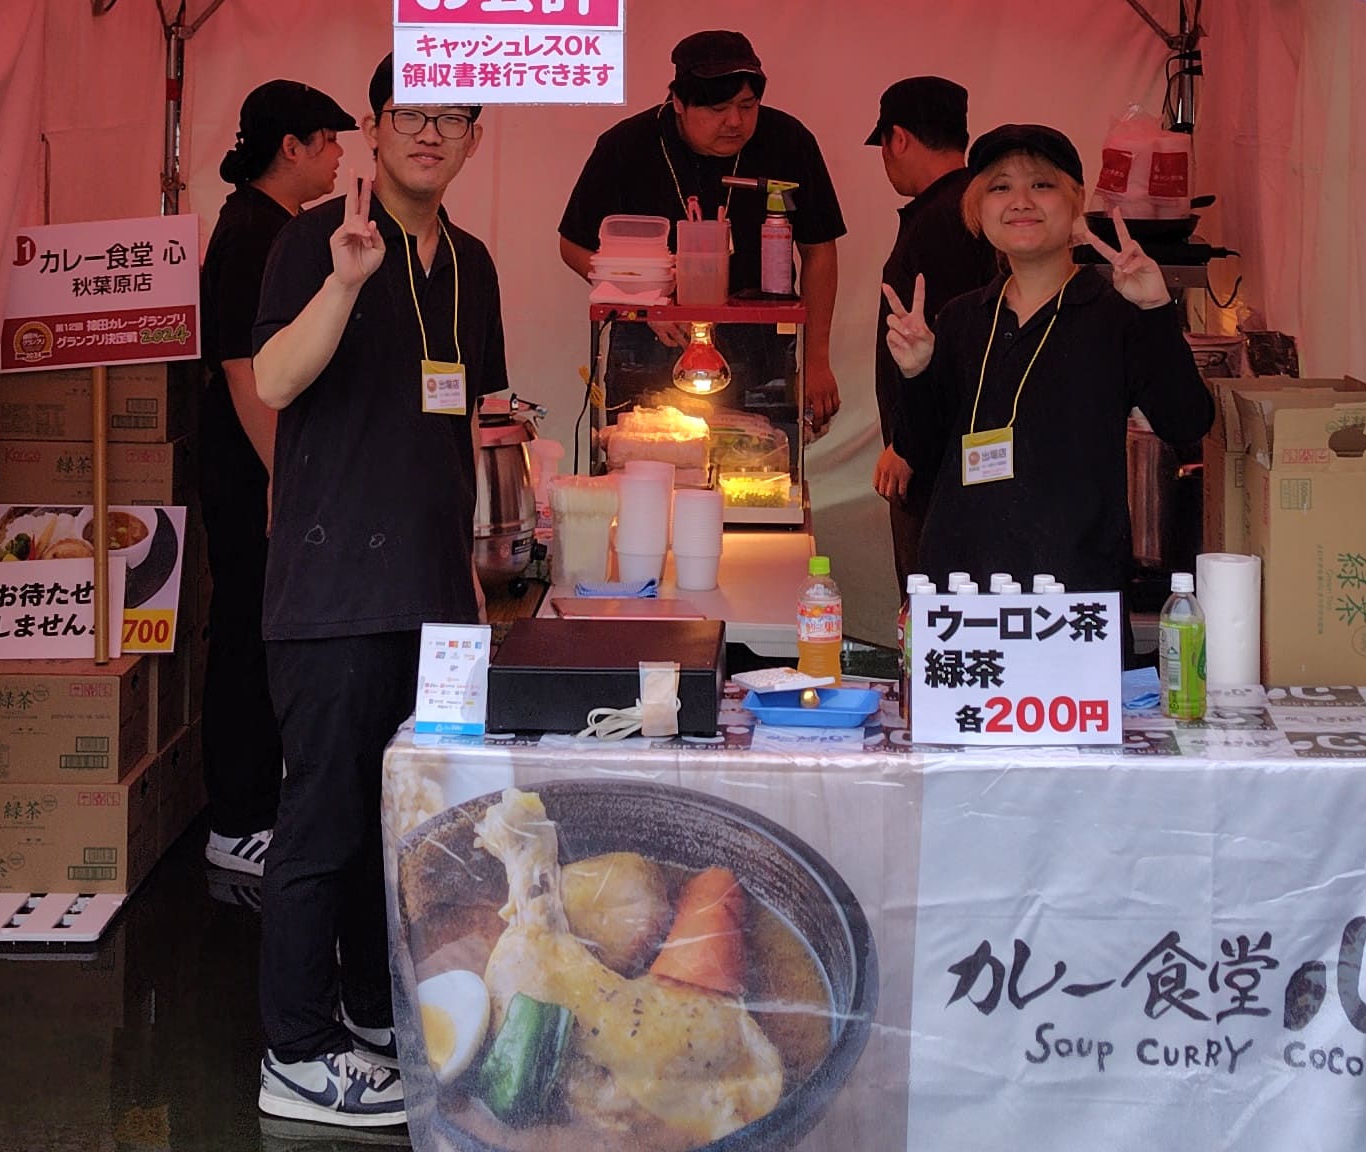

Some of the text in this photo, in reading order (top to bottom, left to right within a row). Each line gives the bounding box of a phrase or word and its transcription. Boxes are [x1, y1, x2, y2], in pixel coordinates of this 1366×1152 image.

[416, 34, 602, 58] キャッシュレスOK
[402, 62, 615, 88] 領収書発行できます
[39, 239, 186, 274] カレー食堂 心
[72, 273, 153, 297] 秋葉原店
[927, 602, 1109, 642] ウーロン茶
[924, 649, 1005, 688] 緑茶
[955, 696, 1109, 733] 各200円
[4, 801, 42, 819] 緑茶
[946, 930, 1280, 1024] カレー食堂
